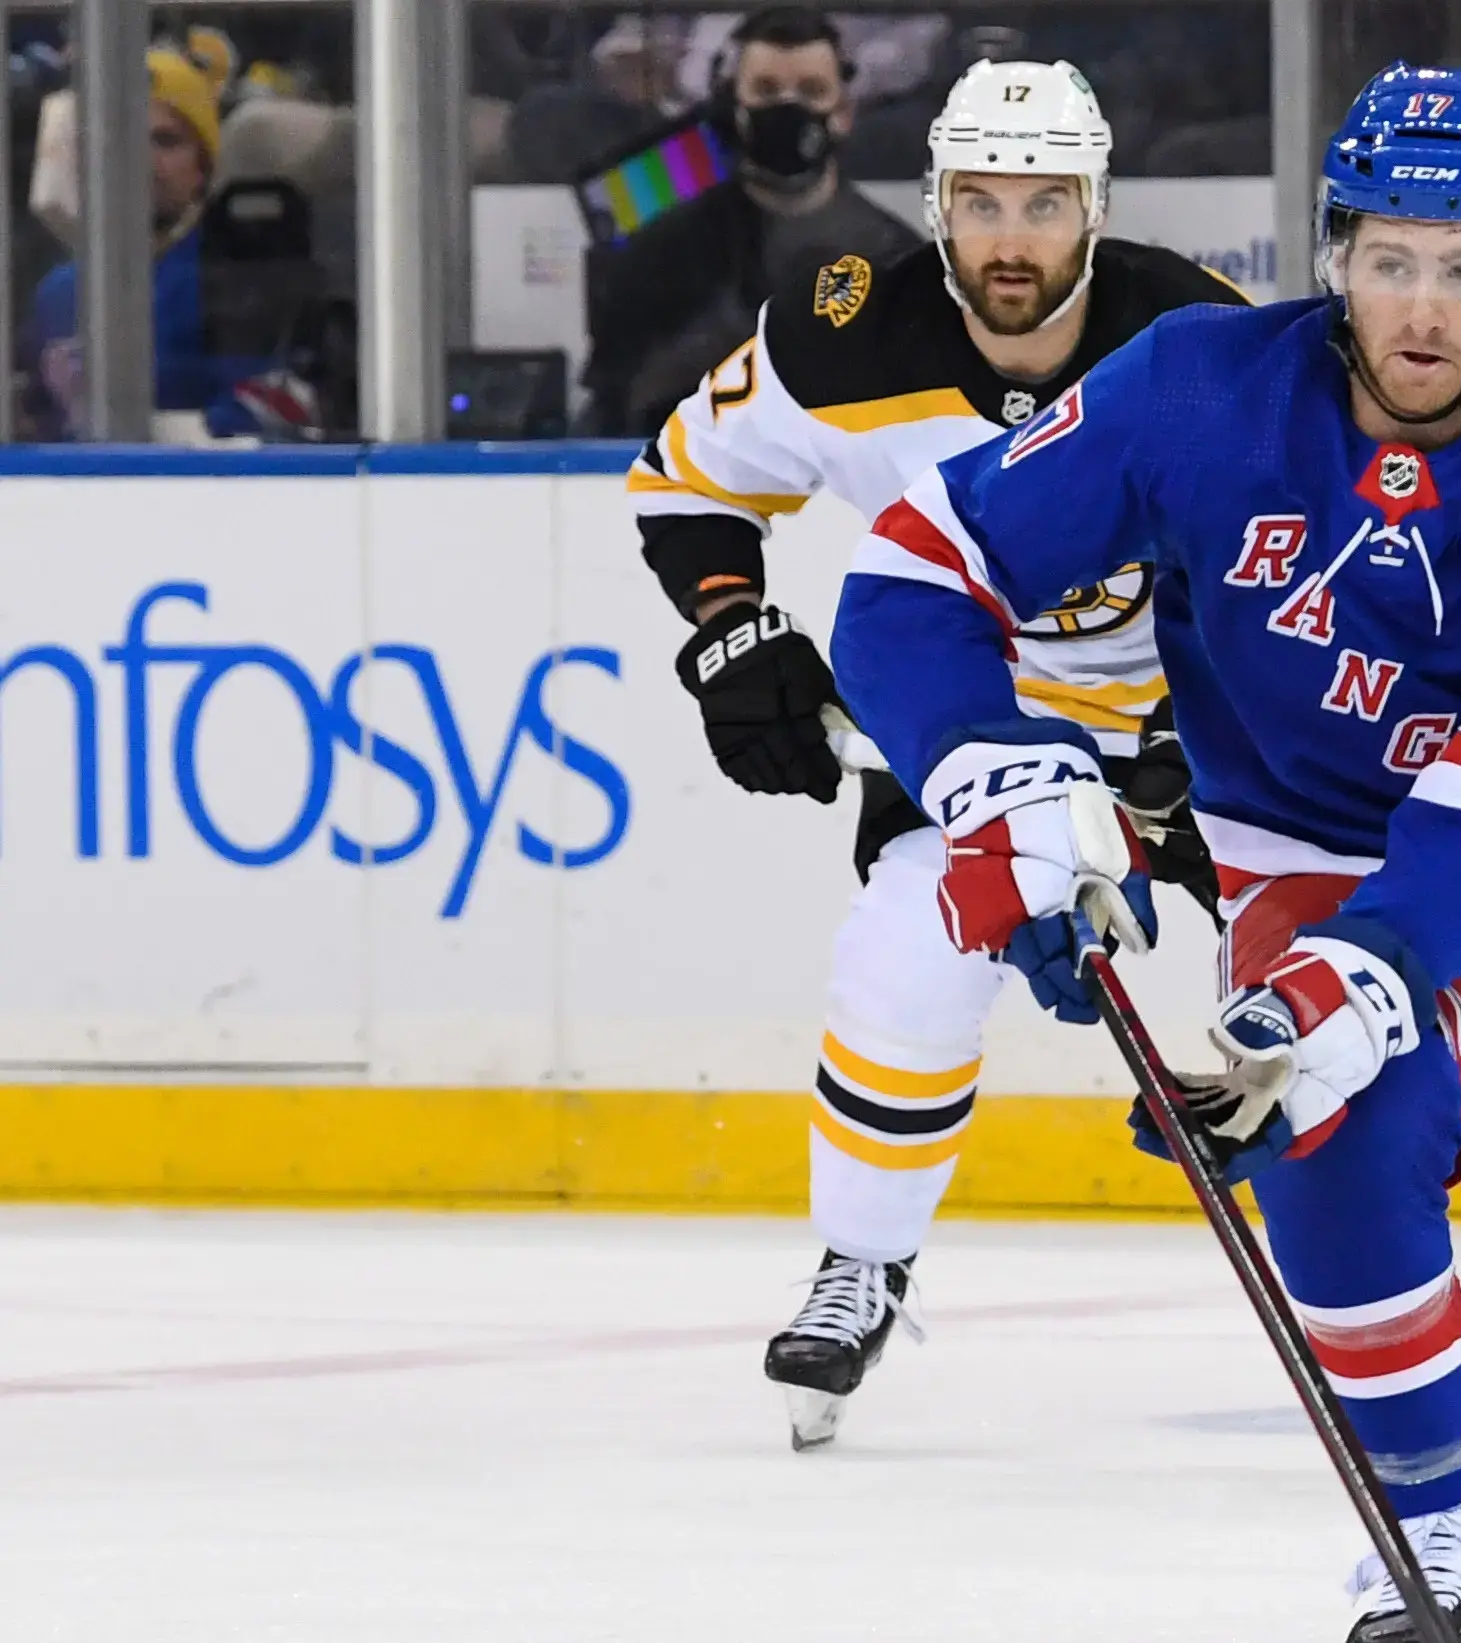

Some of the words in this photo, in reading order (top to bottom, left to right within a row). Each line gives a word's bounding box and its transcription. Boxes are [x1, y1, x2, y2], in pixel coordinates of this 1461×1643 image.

[1002, 85, 1032, 102] 17
[1403, 92, 1455, 119] 17
[1391, 165, 1460, 182] CCM
[937, 760, 1099, 828] CCM
